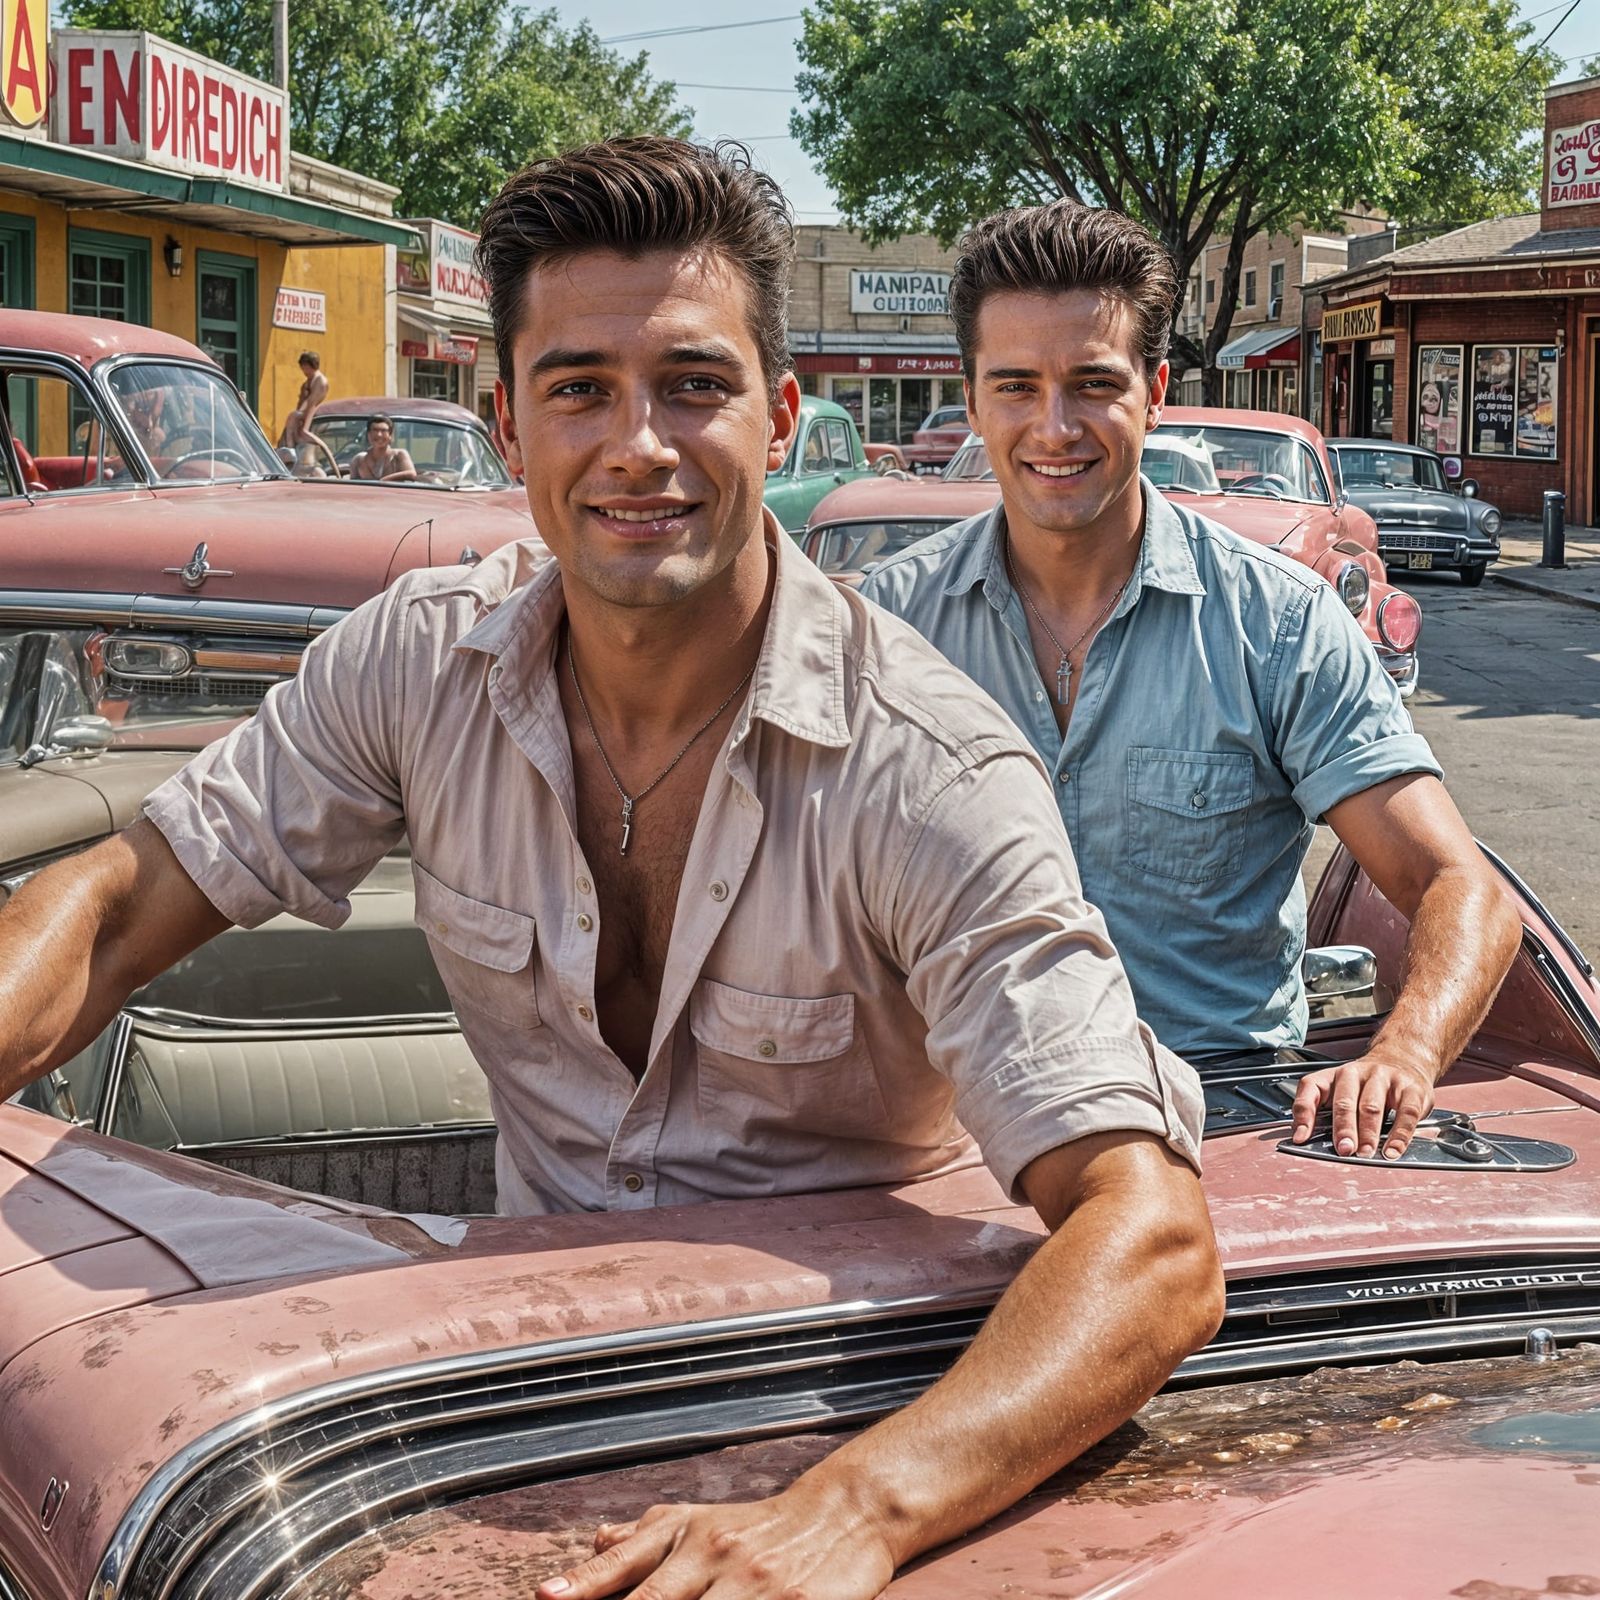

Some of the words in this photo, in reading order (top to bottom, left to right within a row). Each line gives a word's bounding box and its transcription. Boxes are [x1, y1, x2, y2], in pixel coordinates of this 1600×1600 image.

[7, 0, 42, 113] A
[47, 48, 141, 145] EN
[151, 54, 282, 185] DIREDICH
